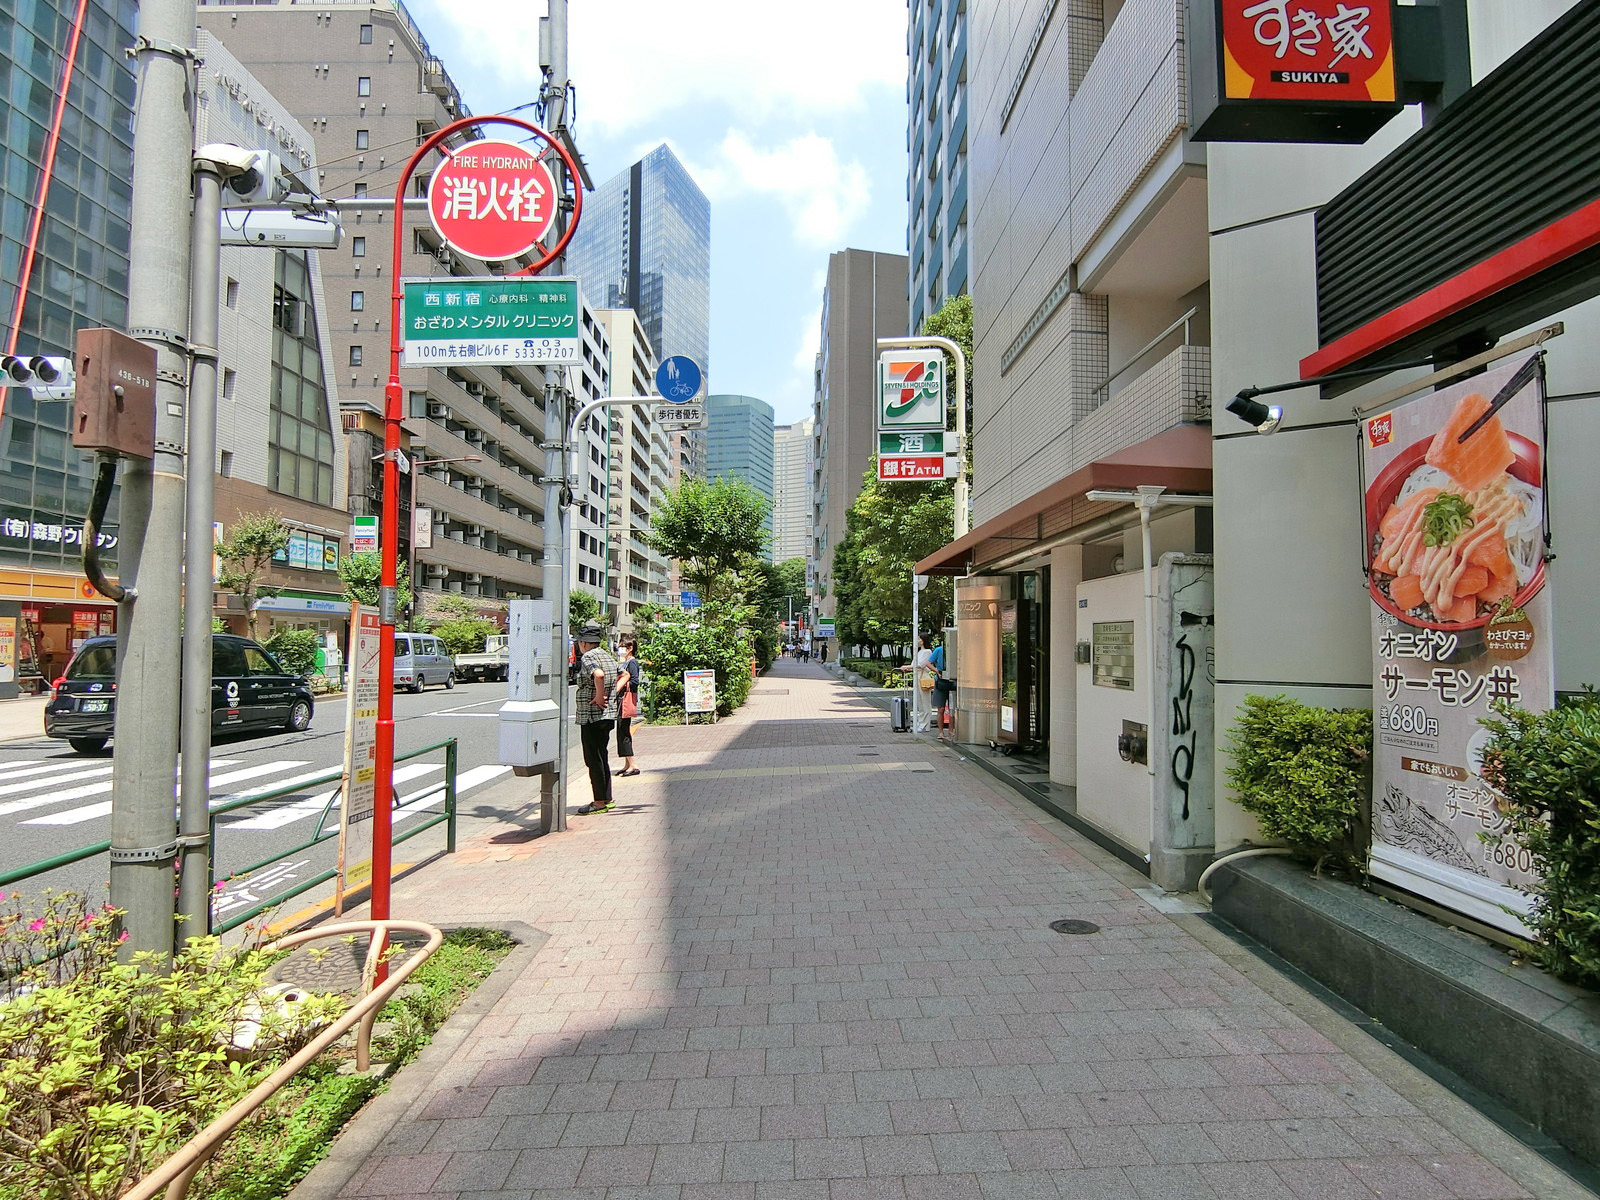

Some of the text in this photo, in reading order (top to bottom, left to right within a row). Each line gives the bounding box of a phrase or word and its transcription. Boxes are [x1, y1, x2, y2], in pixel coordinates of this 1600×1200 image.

[1242, 0, 1374, 69] すき家
[1281, 71, 1338, 84] SUKIYA
[453, 156, 535, 170] FIRE HYDRANT
[442, 176, 545, 222] 消火栓
[425, 292, 481, 306] 西新宿
[417, 344, 509, 358] 100m先右側ビル6F
[515, 347, 574, 359] 5333-7207
[909, 381, 939, 389] HOLDINGS
[658, 409, 700, 420] 歩行者優先
[899, 434, 925, 453] 酒
[290, 543, 322, 559] カラオケ
[313, 602, 335, 610] FamilyMart
[1486, 630, 1532, 641] わさびマヨが
[1380, 629, 1457, 661] オニオン
[1489, 642, 1528, 650] かかっています。
[1381, 665, 1521, 713] サーモン丼
[1390, 703, 1439, 738] 680円
[1410, 760, 1459, 777] 家でもおいしい
[1446, 783, 1494, 806] オニオン
